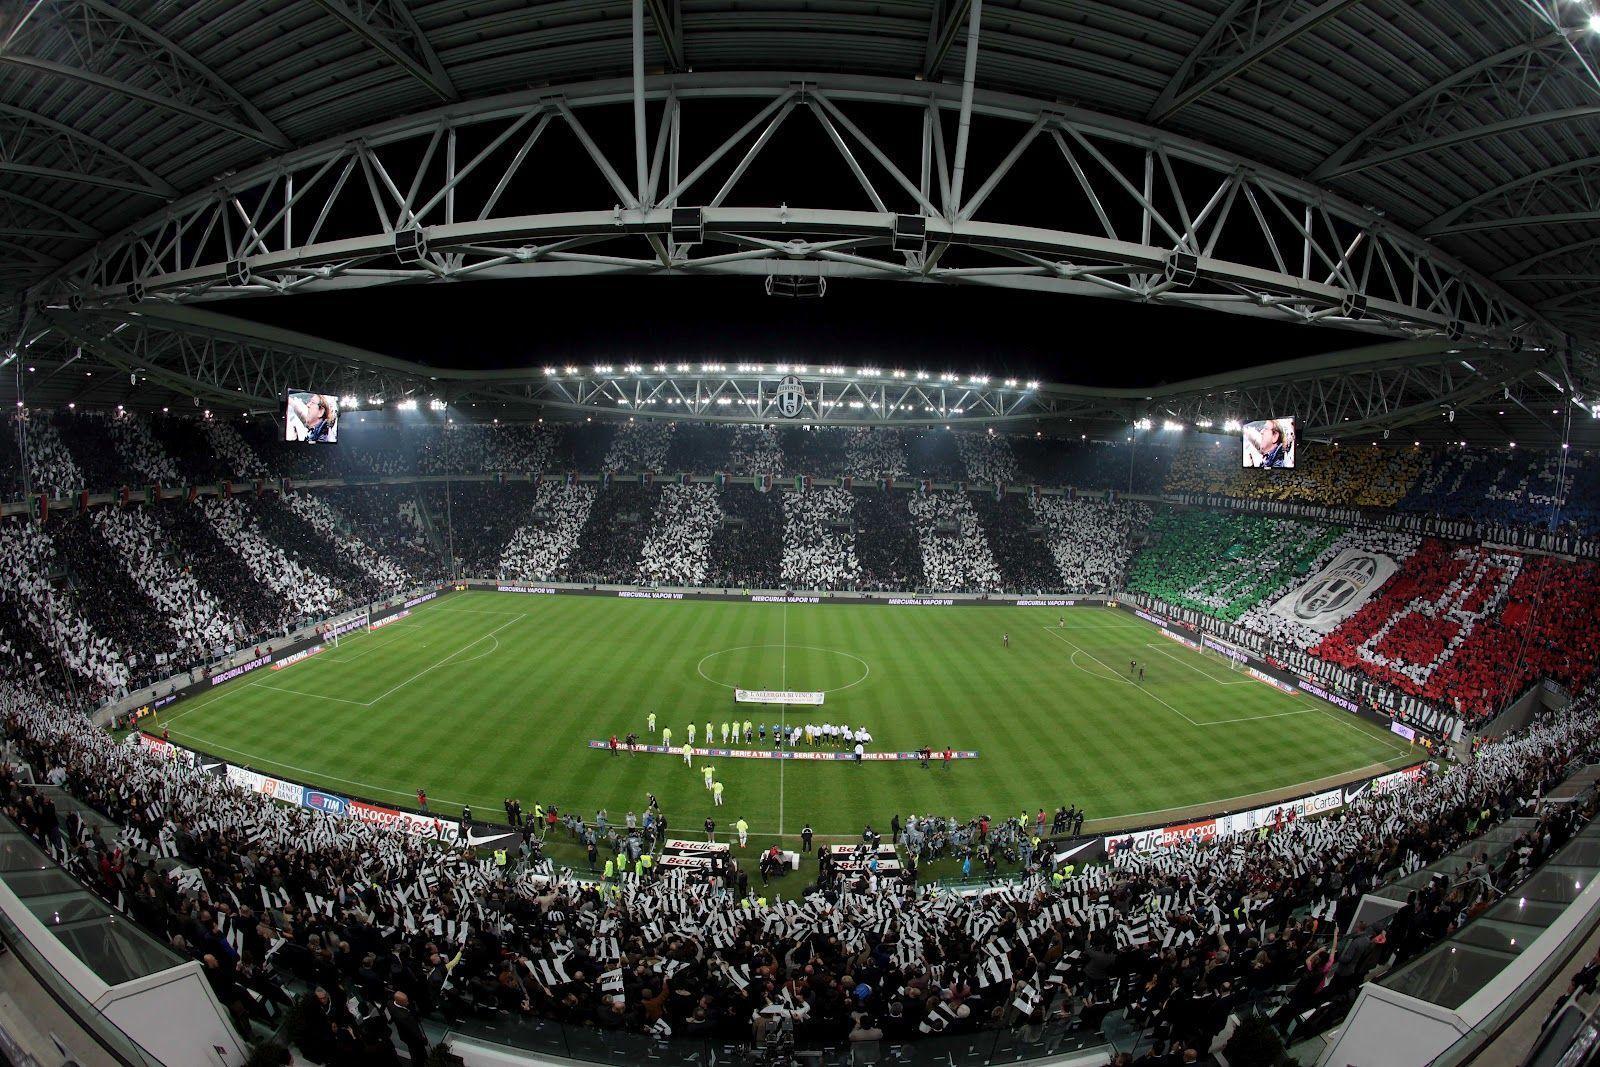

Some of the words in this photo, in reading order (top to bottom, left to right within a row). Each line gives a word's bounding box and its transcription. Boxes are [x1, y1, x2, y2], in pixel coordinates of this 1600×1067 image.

[1267, 502, 1287, 513] STATO
[1290, 504, 1298, 514] IN
[1301, 506, 1327, 518] CAMPO
[1404, 516, 1421, 530] CHE
[1434, 520, 1473, 537] VOSTRO
[1486, 528, 1519, 544] STATO
[1540, 534, 1569, 553] AULA
[276, 660, 287, 670] TIM
[287, 650, 308, 664] YOUNG
[1153, 600, 1168, 615] NON
[1183, 610, 1199, 625] MAI
[1201, 615, 1225, 635] STATO
[1282, 648, 1357, 692] PRESCRIZIONE
[1377, 688, 1394, 708] HA
[212, 665, 244, 686] MERCURIAL
[243, 659, 263, 674] VAPOR
[1249, 667, 1259, 676] TIM
[1259, 671, 1278, 686] YOUNG
[1298, 680, 1328, 700] MERCURIAL
[1328, 693, 1349, 709] VAPOR
[1347, 702, 1359, 714] VIII
[277, 790, 299, 803] BANCA
[279, 783, 303, 796] VENETO
[322, 797, 339, 811] TIM
[1313, 791, 1342, 812] CartaSi
[349, 805, 400, 827] BALOCCO
[403, 815, 458, 841] Betic
[1163, 823, 1215, 844] BALOCCO
[1107, 831, 1163, 855] Bclic
